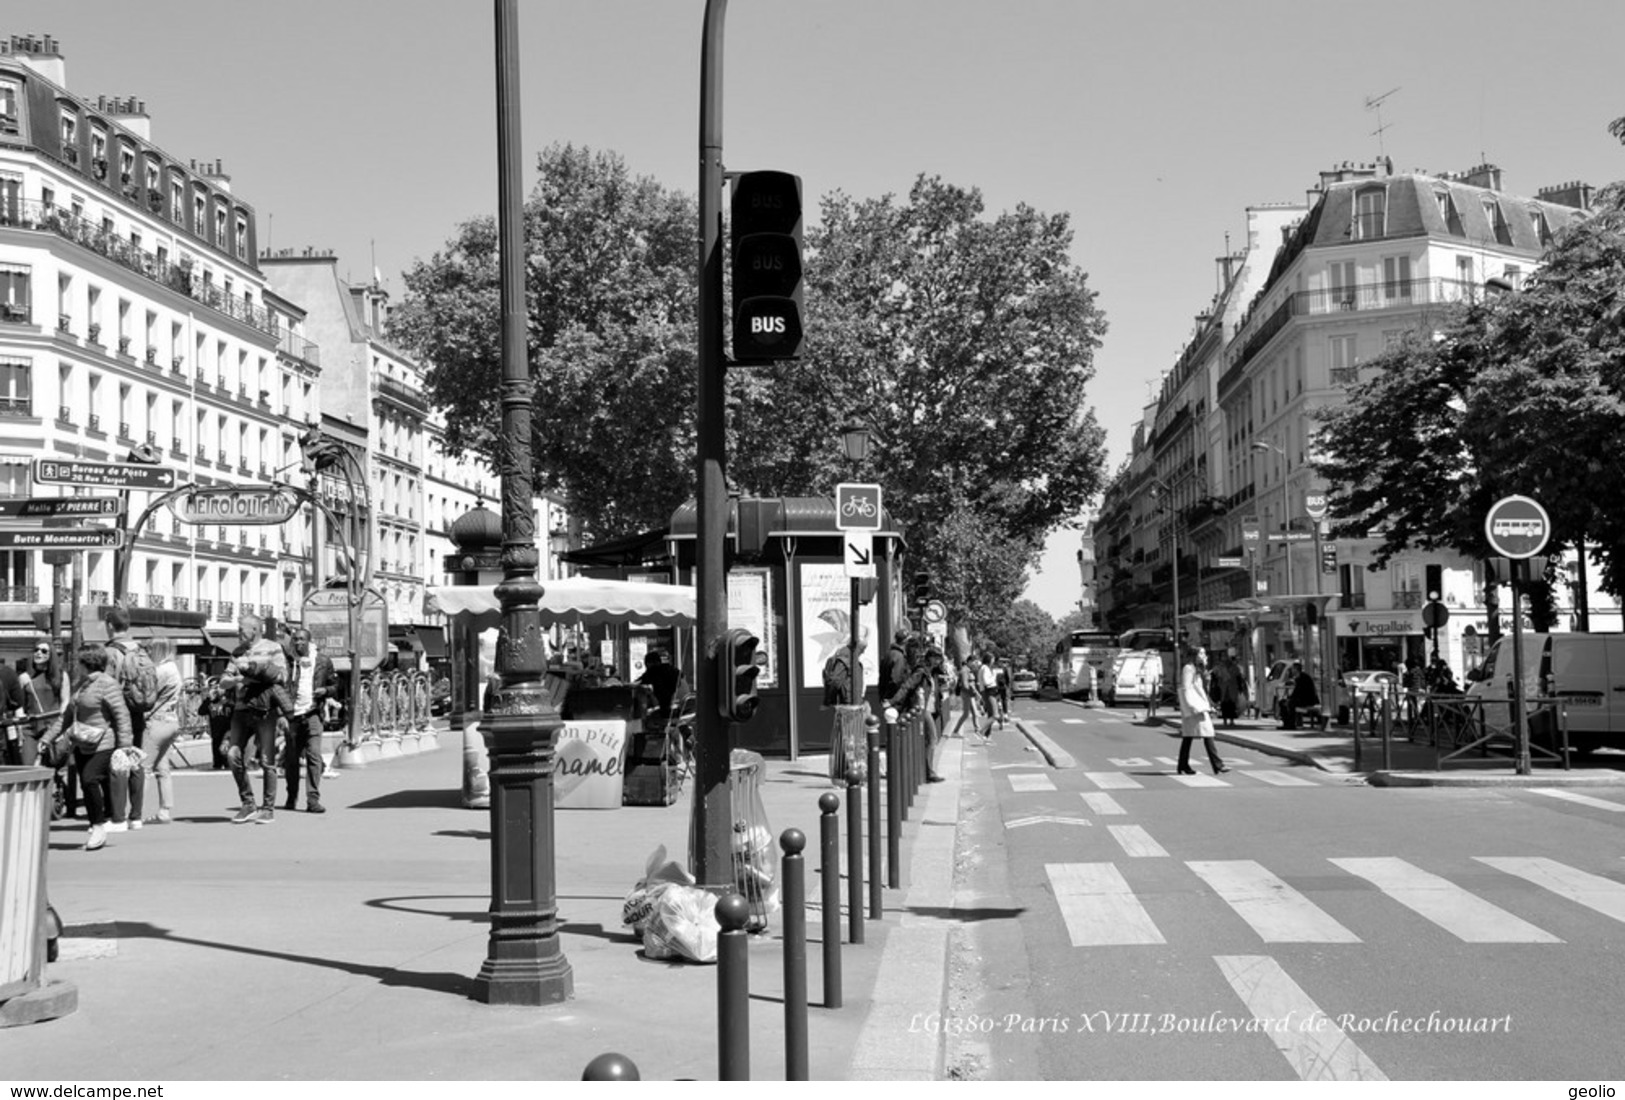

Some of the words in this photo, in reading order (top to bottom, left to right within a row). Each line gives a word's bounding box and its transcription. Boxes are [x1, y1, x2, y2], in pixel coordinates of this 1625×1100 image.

[752, 255, 783, 270] BUS
[751, 316, 786, 333] BUS
[71, 464, 105, 474] Bureau
[107, 467, 119, 476] de
[84, 474, 100, 482] Rue
[66, 502, 100, 512] PIERRE
[186, 492, 286, 517] METROPOLITAIN
[1305, 495, 1326, 507] BUS
[13, 534, 41, 544] Butte
[43, 534, 100, 544] Montmartre
[1365, 620, 1414, 636] legallais
[559, 727, 579, 739] on
[553, 756, 623, 777] ramel
